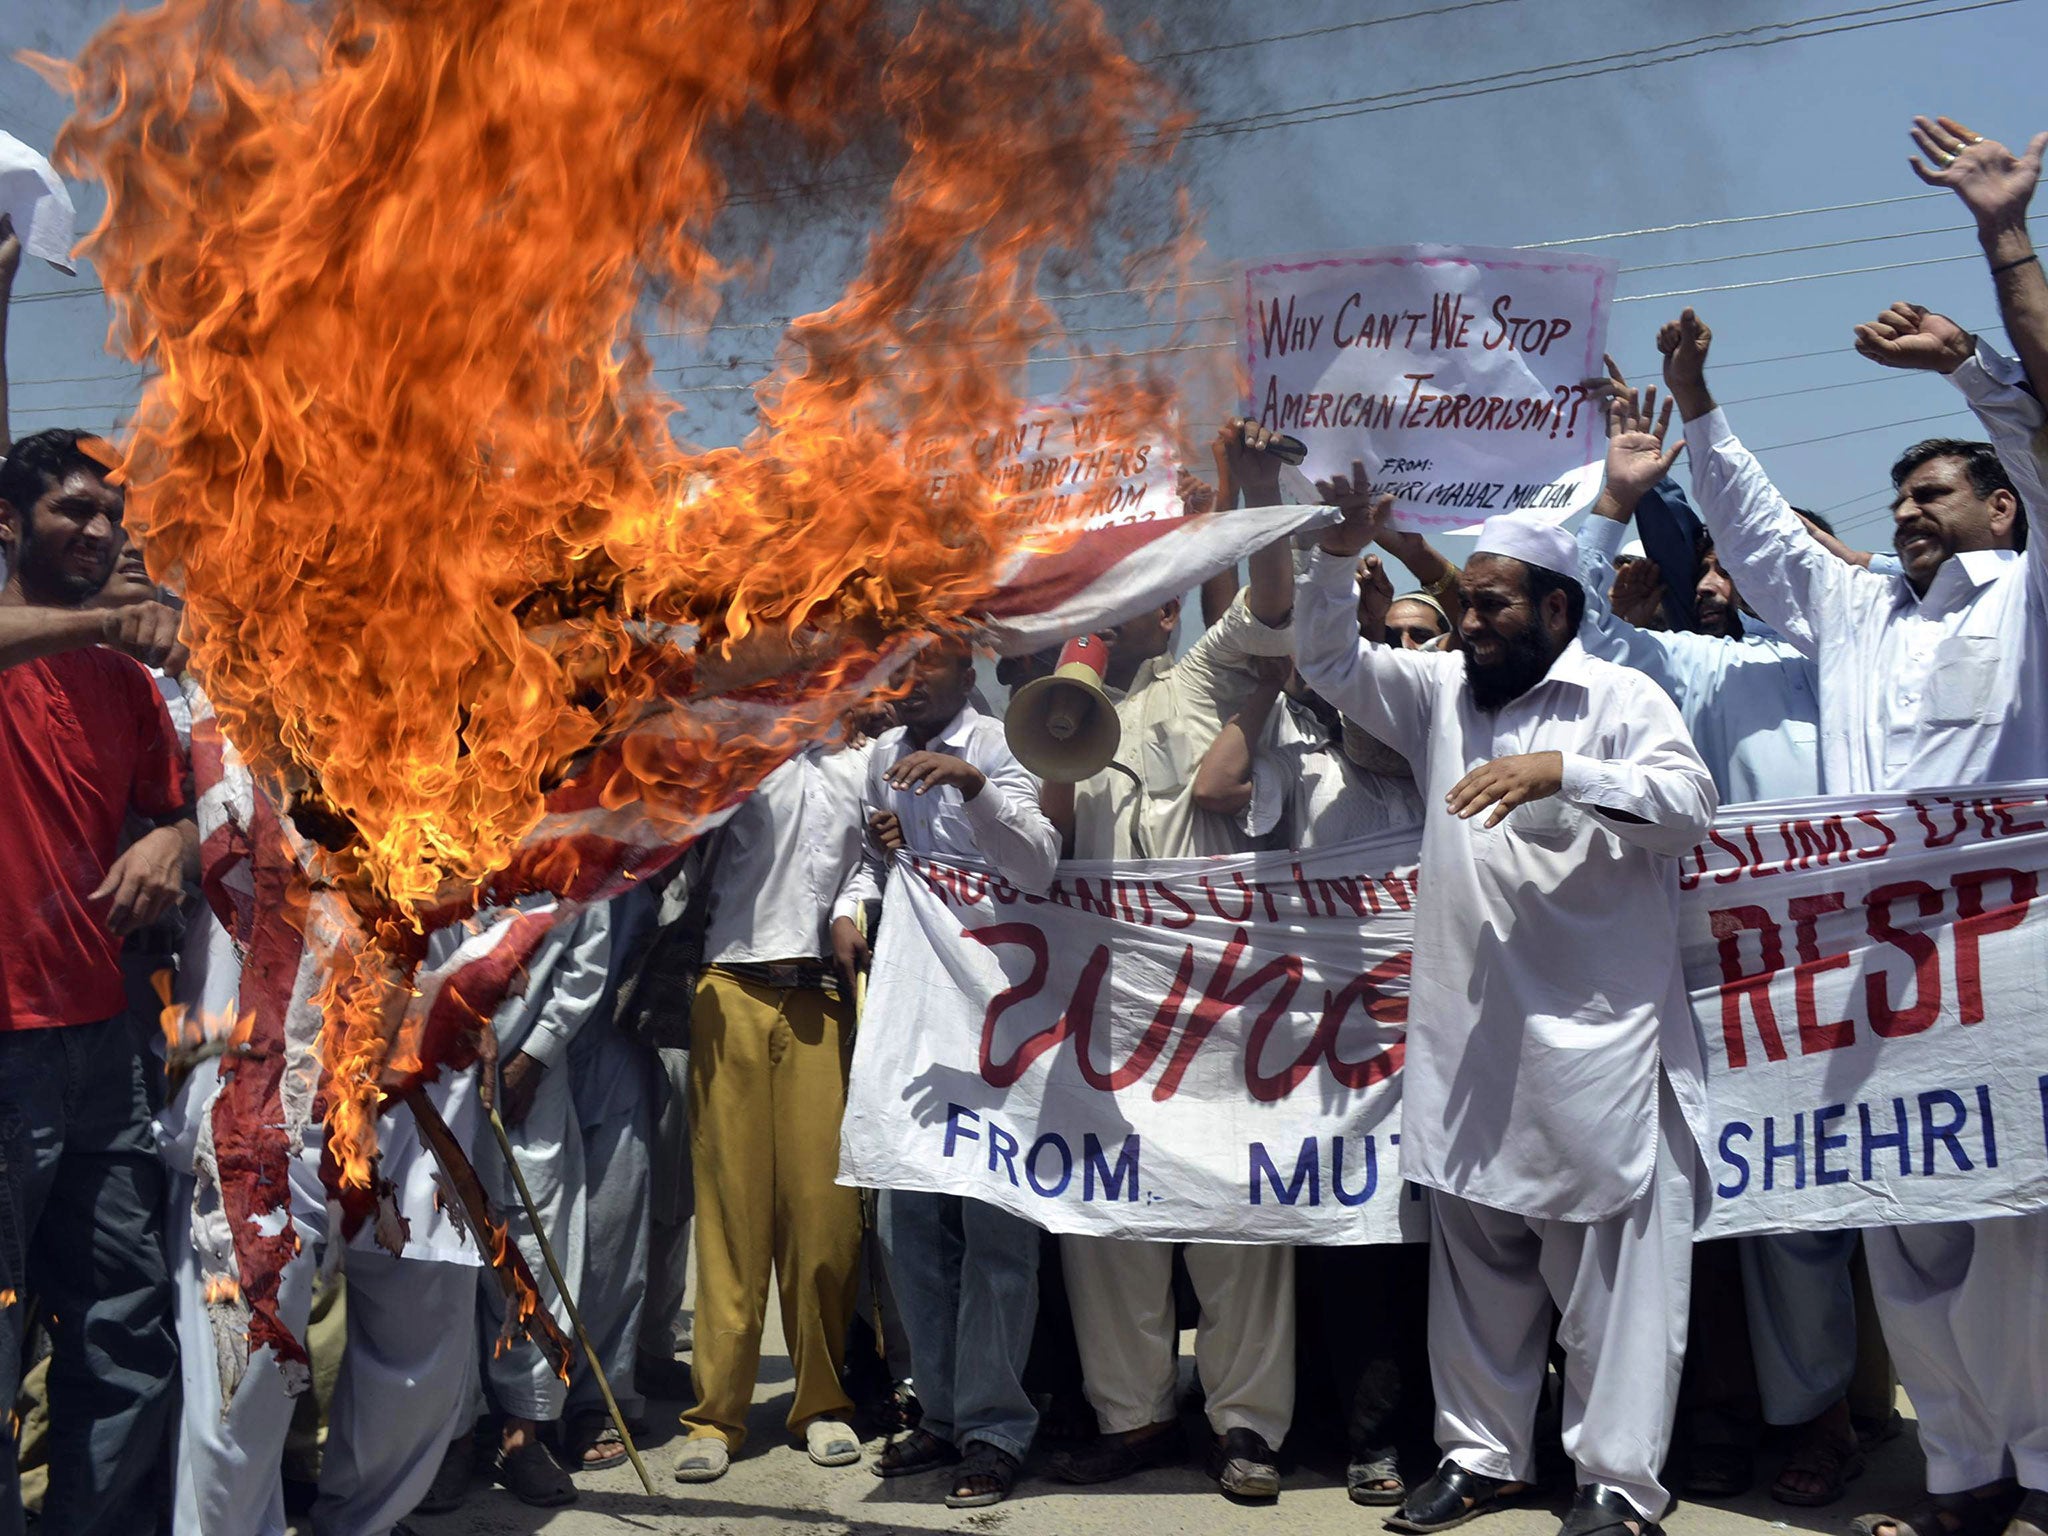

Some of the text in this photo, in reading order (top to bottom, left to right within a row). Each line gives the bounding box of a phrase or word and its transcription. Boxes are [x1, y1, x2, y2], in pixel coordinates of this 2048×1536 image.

[1259, 292, 1572, 359] WHY CAN'T WE STOP
[1261, 373, 1589, 439] AMERICAN TERRORISM??
[1029, 445, 1152, 491] BROTHERS
[1377, 457, 1433, 475] FROM:
[1428, 481, 1504, 509] MAHAZ
[1077, 482, 1148, 519] FROM
[1290, 855, 1419, 917] INN
[1708, 866, 2039, 1069] RESP
[1716, 1083, 1998, 1200] SHEHRI
